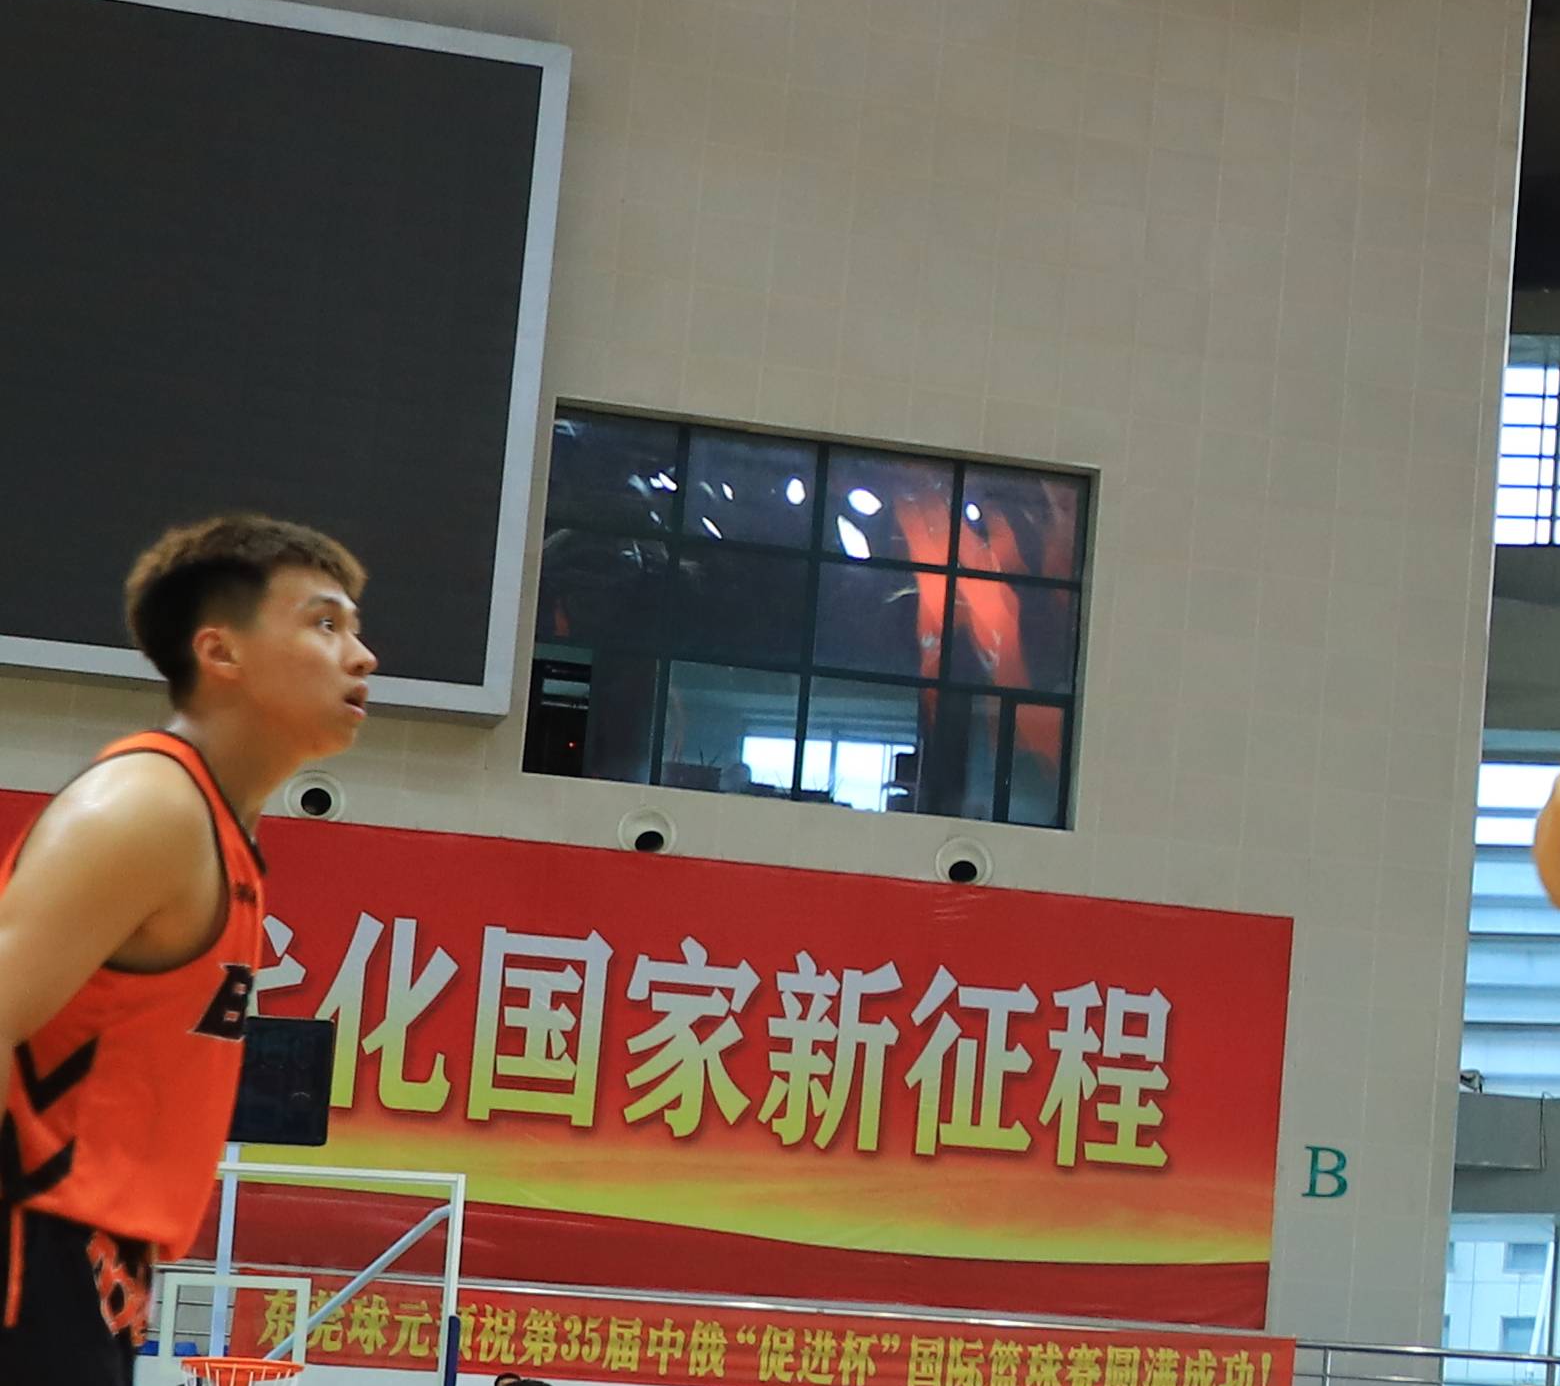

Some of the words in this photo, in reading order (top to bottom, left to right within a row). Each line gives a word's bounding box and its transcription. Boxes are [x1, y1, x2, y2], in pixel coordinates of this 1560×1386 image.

[256, 909, 1172, 1169] 化国家新征程
[1301, 1145, 1350, 1201] B
